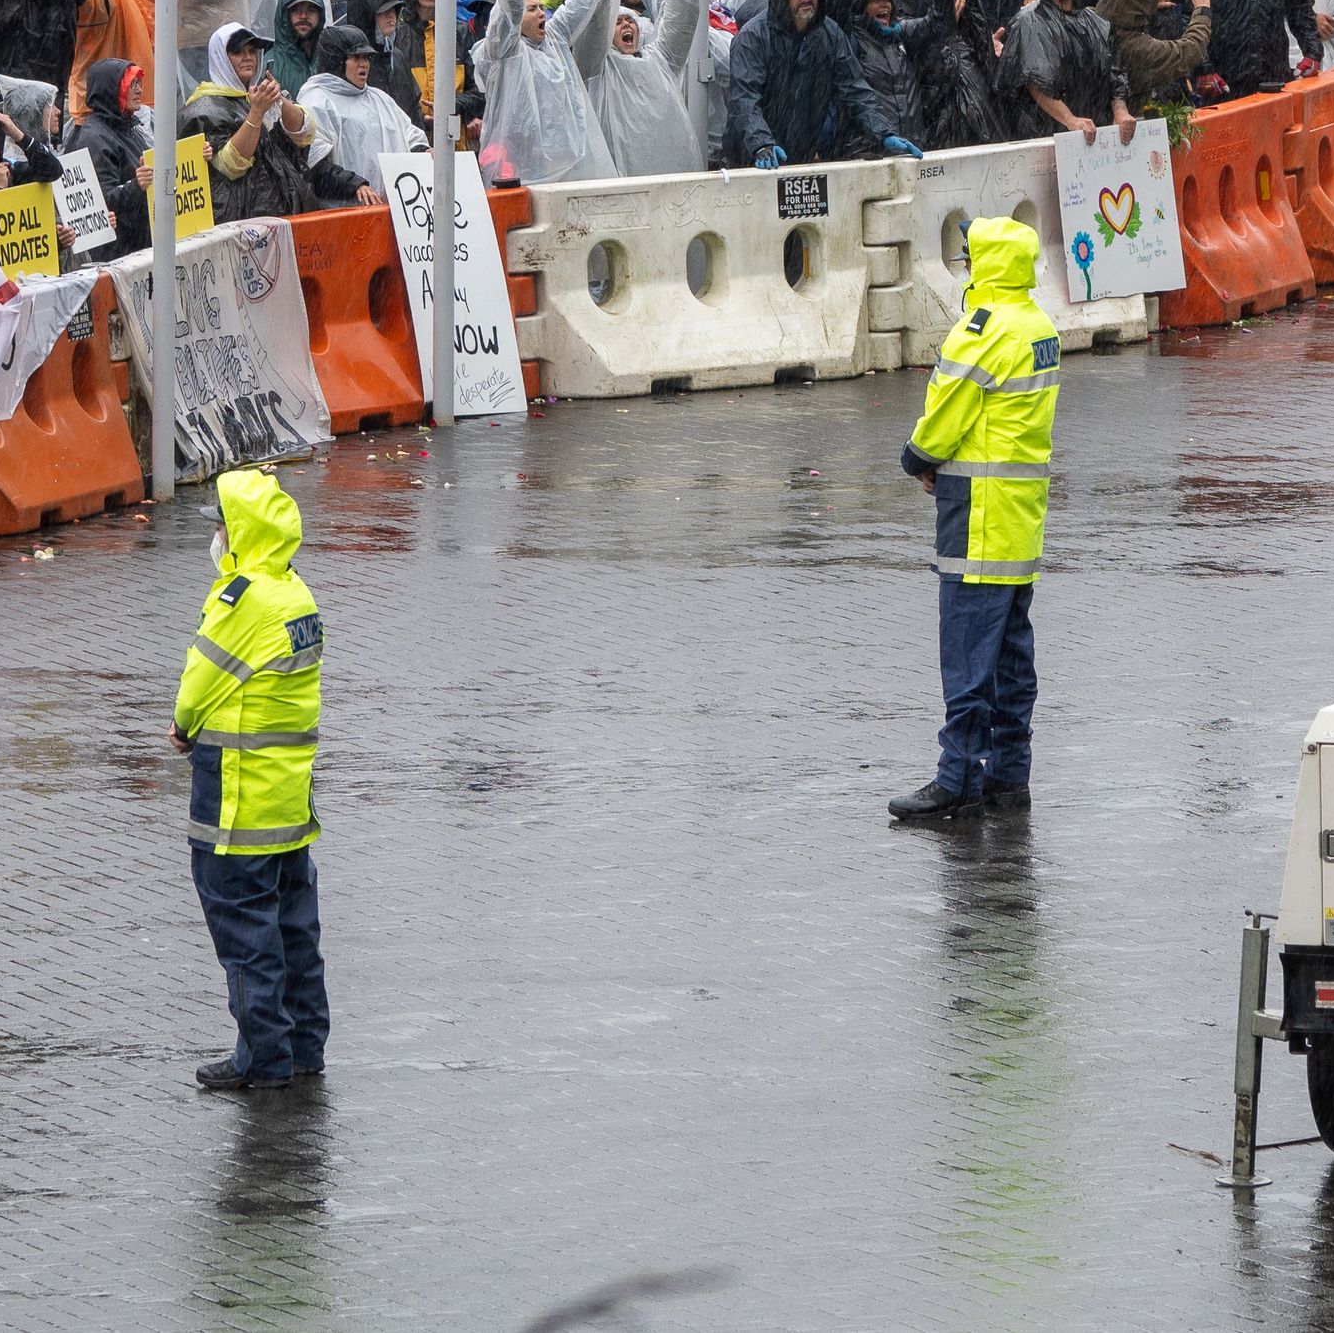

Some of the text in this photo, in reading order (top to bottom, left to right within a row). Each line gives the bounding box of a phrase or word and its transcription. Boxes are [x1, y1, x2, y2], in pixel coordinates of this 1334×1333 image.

[61, 164, 86, 189] END ALL
[181, 160, 198, 184] ALL
[784, 179, 820, 196] RSEA
[65, 192, 94, 214] COVID-19
[174, 186, 206, 217] DATES
[785, 194, 820, 204] FOR HIRE
[18, 206, 41, 232] ALL
[245, 228, 259, 240] NO
[252, 237, 268, 250] ABS
[247, 278, 264, 295] KIDS
[459, 369, 511, 409] desperate
